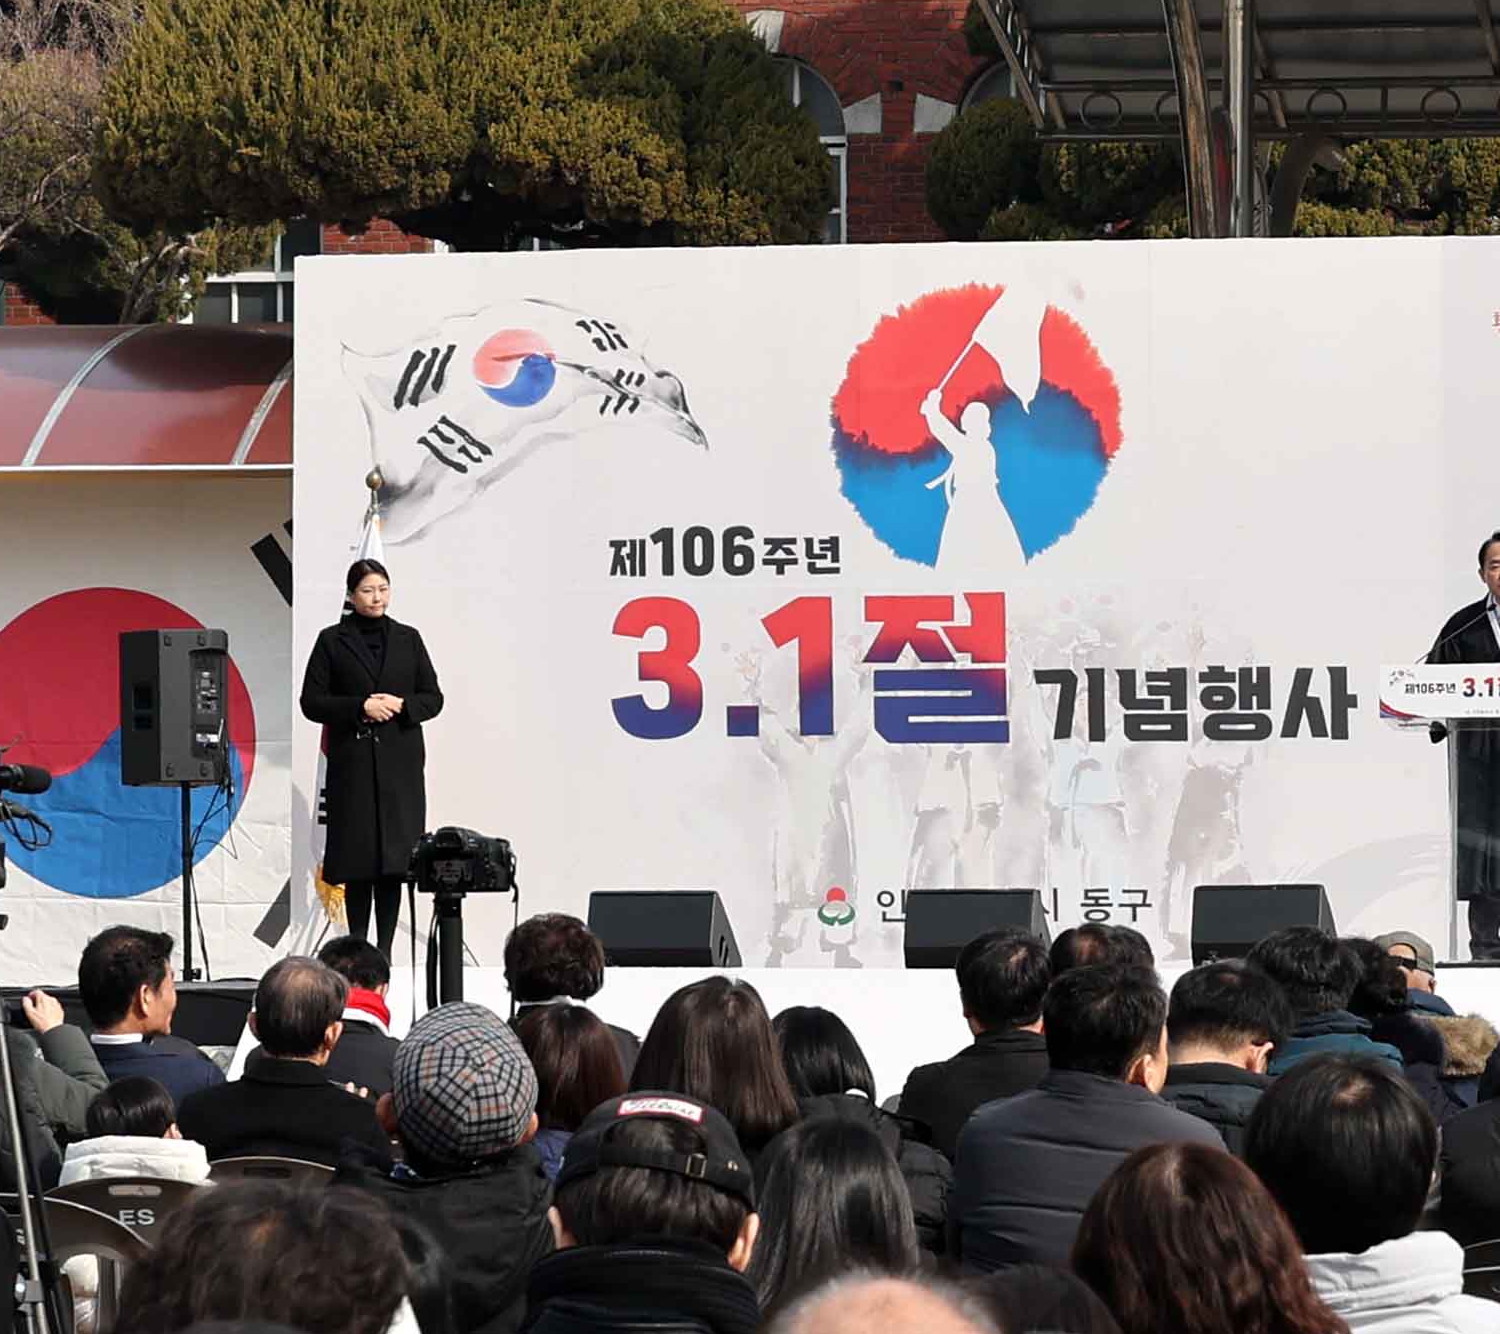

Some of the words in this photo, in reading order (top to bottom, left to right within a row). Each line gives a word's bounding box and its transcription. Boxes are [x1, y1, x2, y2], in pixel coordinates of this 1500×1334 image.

[609, 525, 842, 577] 제106주년
[611, 592, 1010, 743] 3.1절
[1033, 664, 1358, 743] 기념행사
[1404, 682, 1456, 694] 제106주년
[1080, 888, 1152, 922] 동구
[119, 1209, 155, 1225] ES
